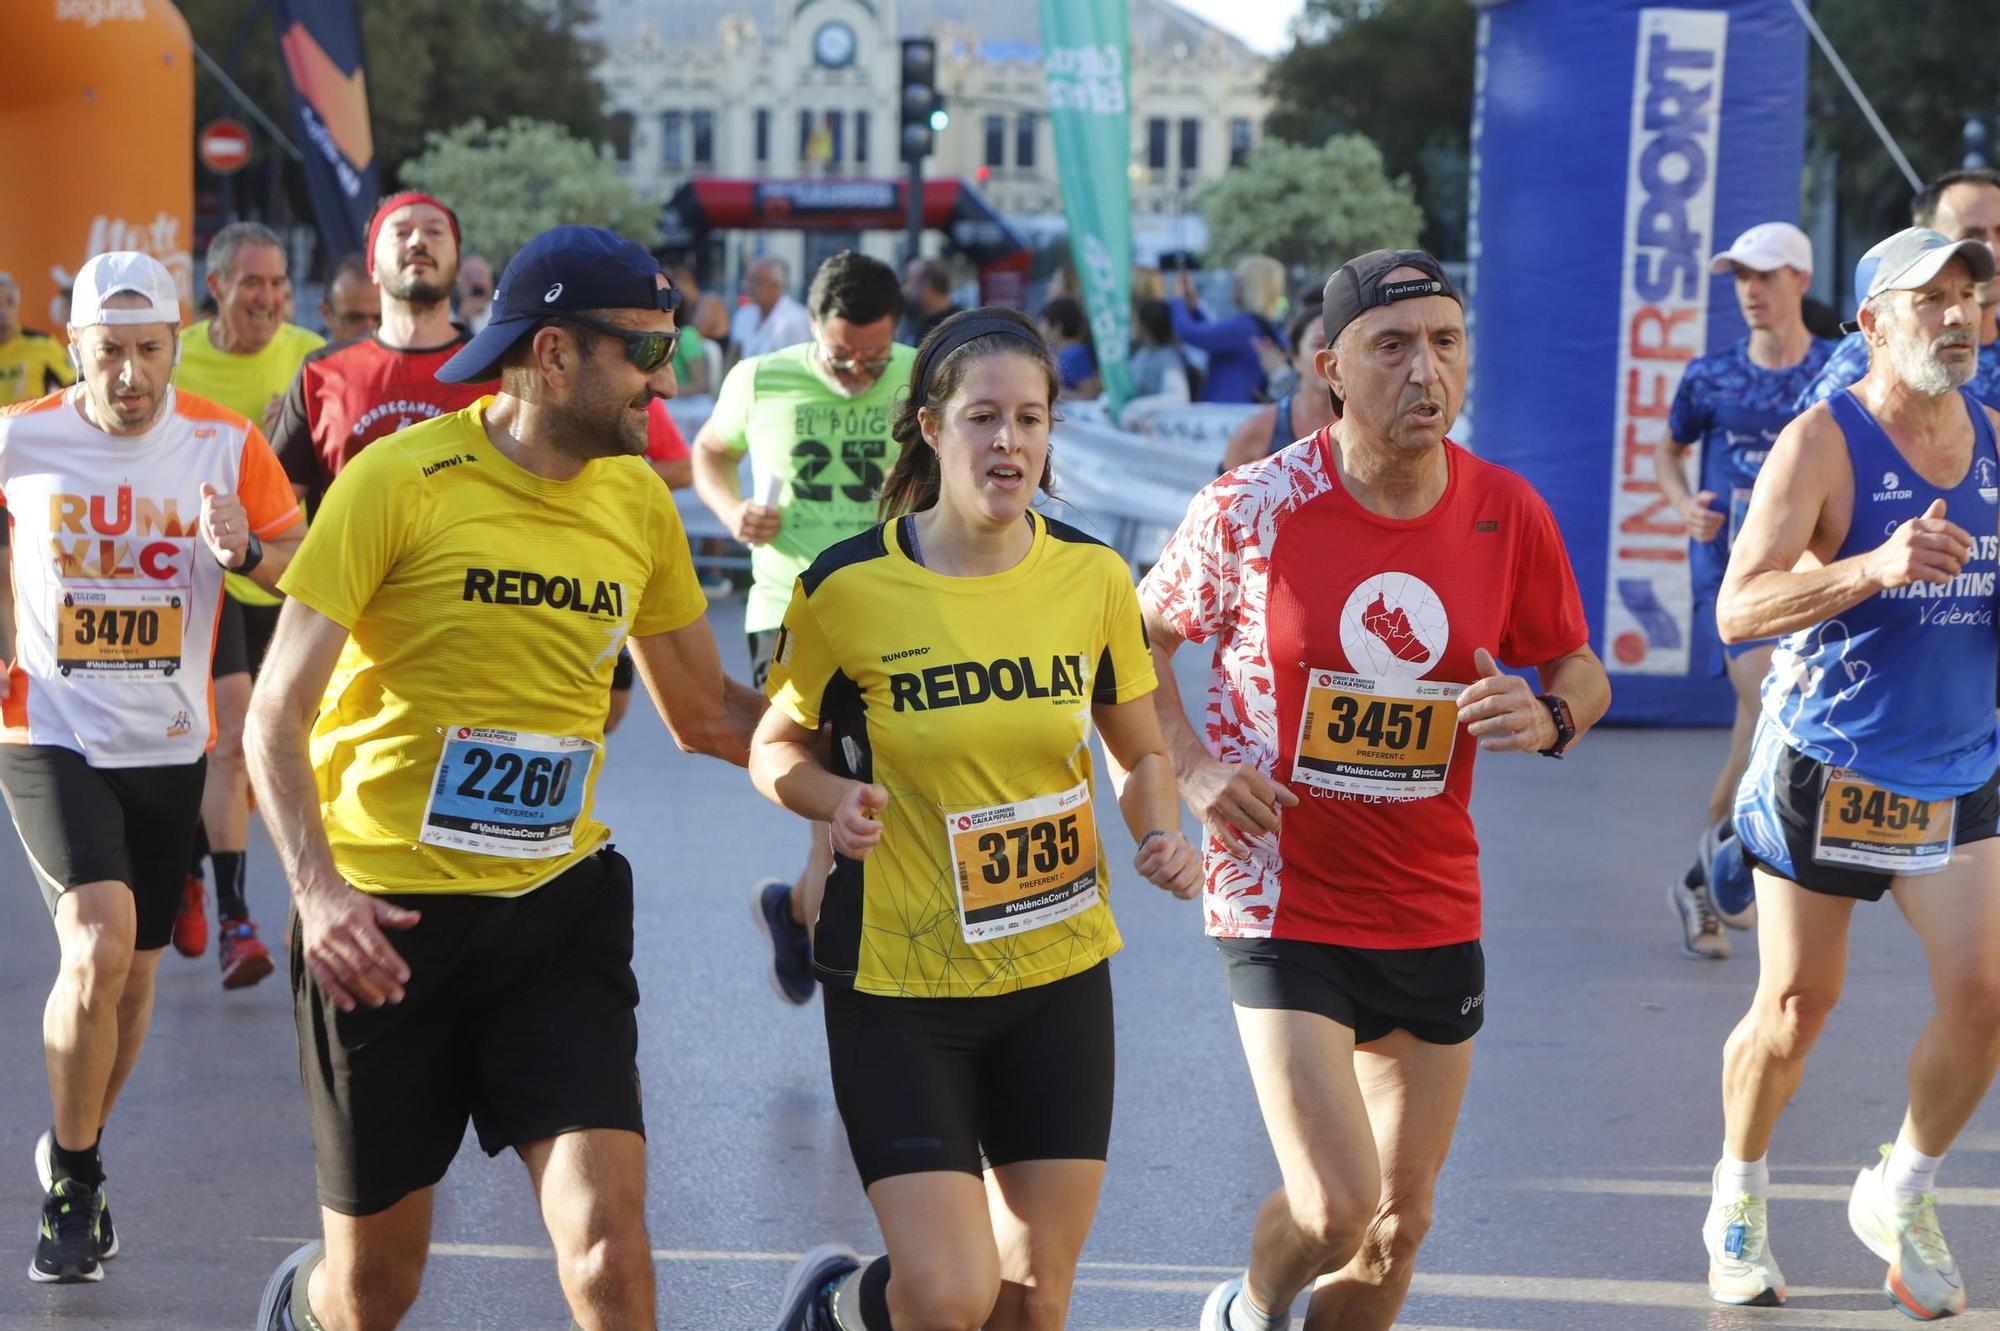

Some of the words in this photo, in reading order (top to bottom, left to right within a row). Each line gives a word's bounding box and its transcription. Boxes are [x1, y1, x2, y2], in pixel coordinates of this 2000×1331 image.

[1618, 33, 1717, 562] INTERSPORT
[795, 418, 815, 435] EL
[830, 417, 887, 435] PUIG
[790, 439, 886, 502] 25
[51, 484, 198, 537] RUN
[1873, 490, 1912, 502] VIATOR
[75, 608, 159, 646] 3470
[1327, 696, 1433, 750] 3451
[1356, 750, 1398, 760] PREFERENT
[457, 748, 572, 807] 2260
[1336, 764, 1407, 779] #ValènciaCorre
[494, 807, 539, 818] PREFERENT
[1840, 786, 1930, 831] 3454
[470, 822, 545, 839] #ValènciaCorre
[978, 814, 1079, 884] 3735
[1019, 876, 1059, 890] PREFERENT
[1005, 890, 1070, 914] #ValènciaCorre
